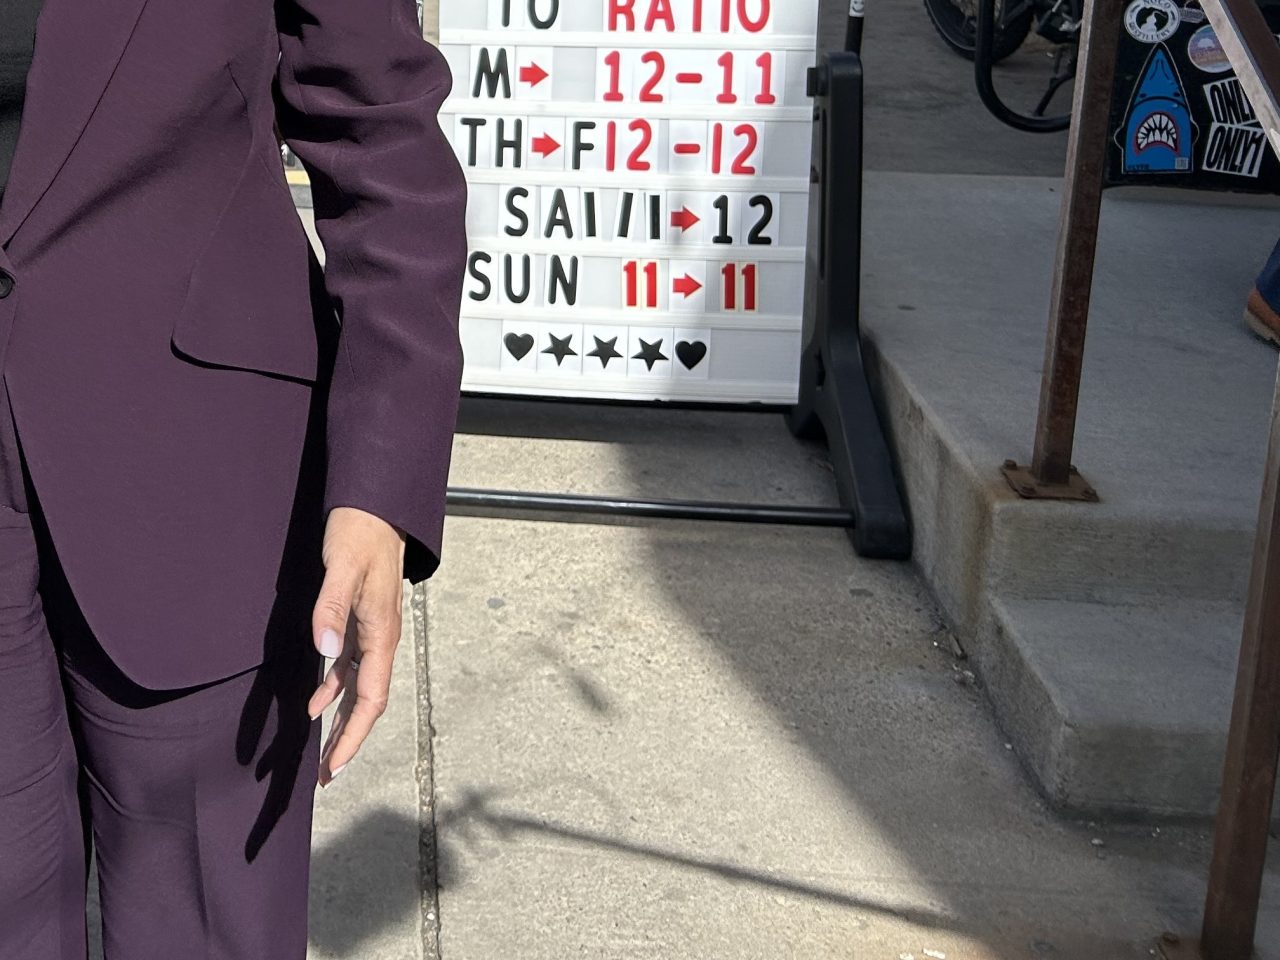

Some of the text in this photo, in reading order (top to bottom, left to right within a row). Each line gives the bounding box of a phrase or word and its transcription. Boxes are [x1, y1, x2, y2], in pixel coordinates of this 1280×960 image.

[472, 47, 512, 99] M
[460, 117, 522, 169] TH
[712, 194, 773, 246] 12
[467, 250, 758, 311] SUN 11 11
